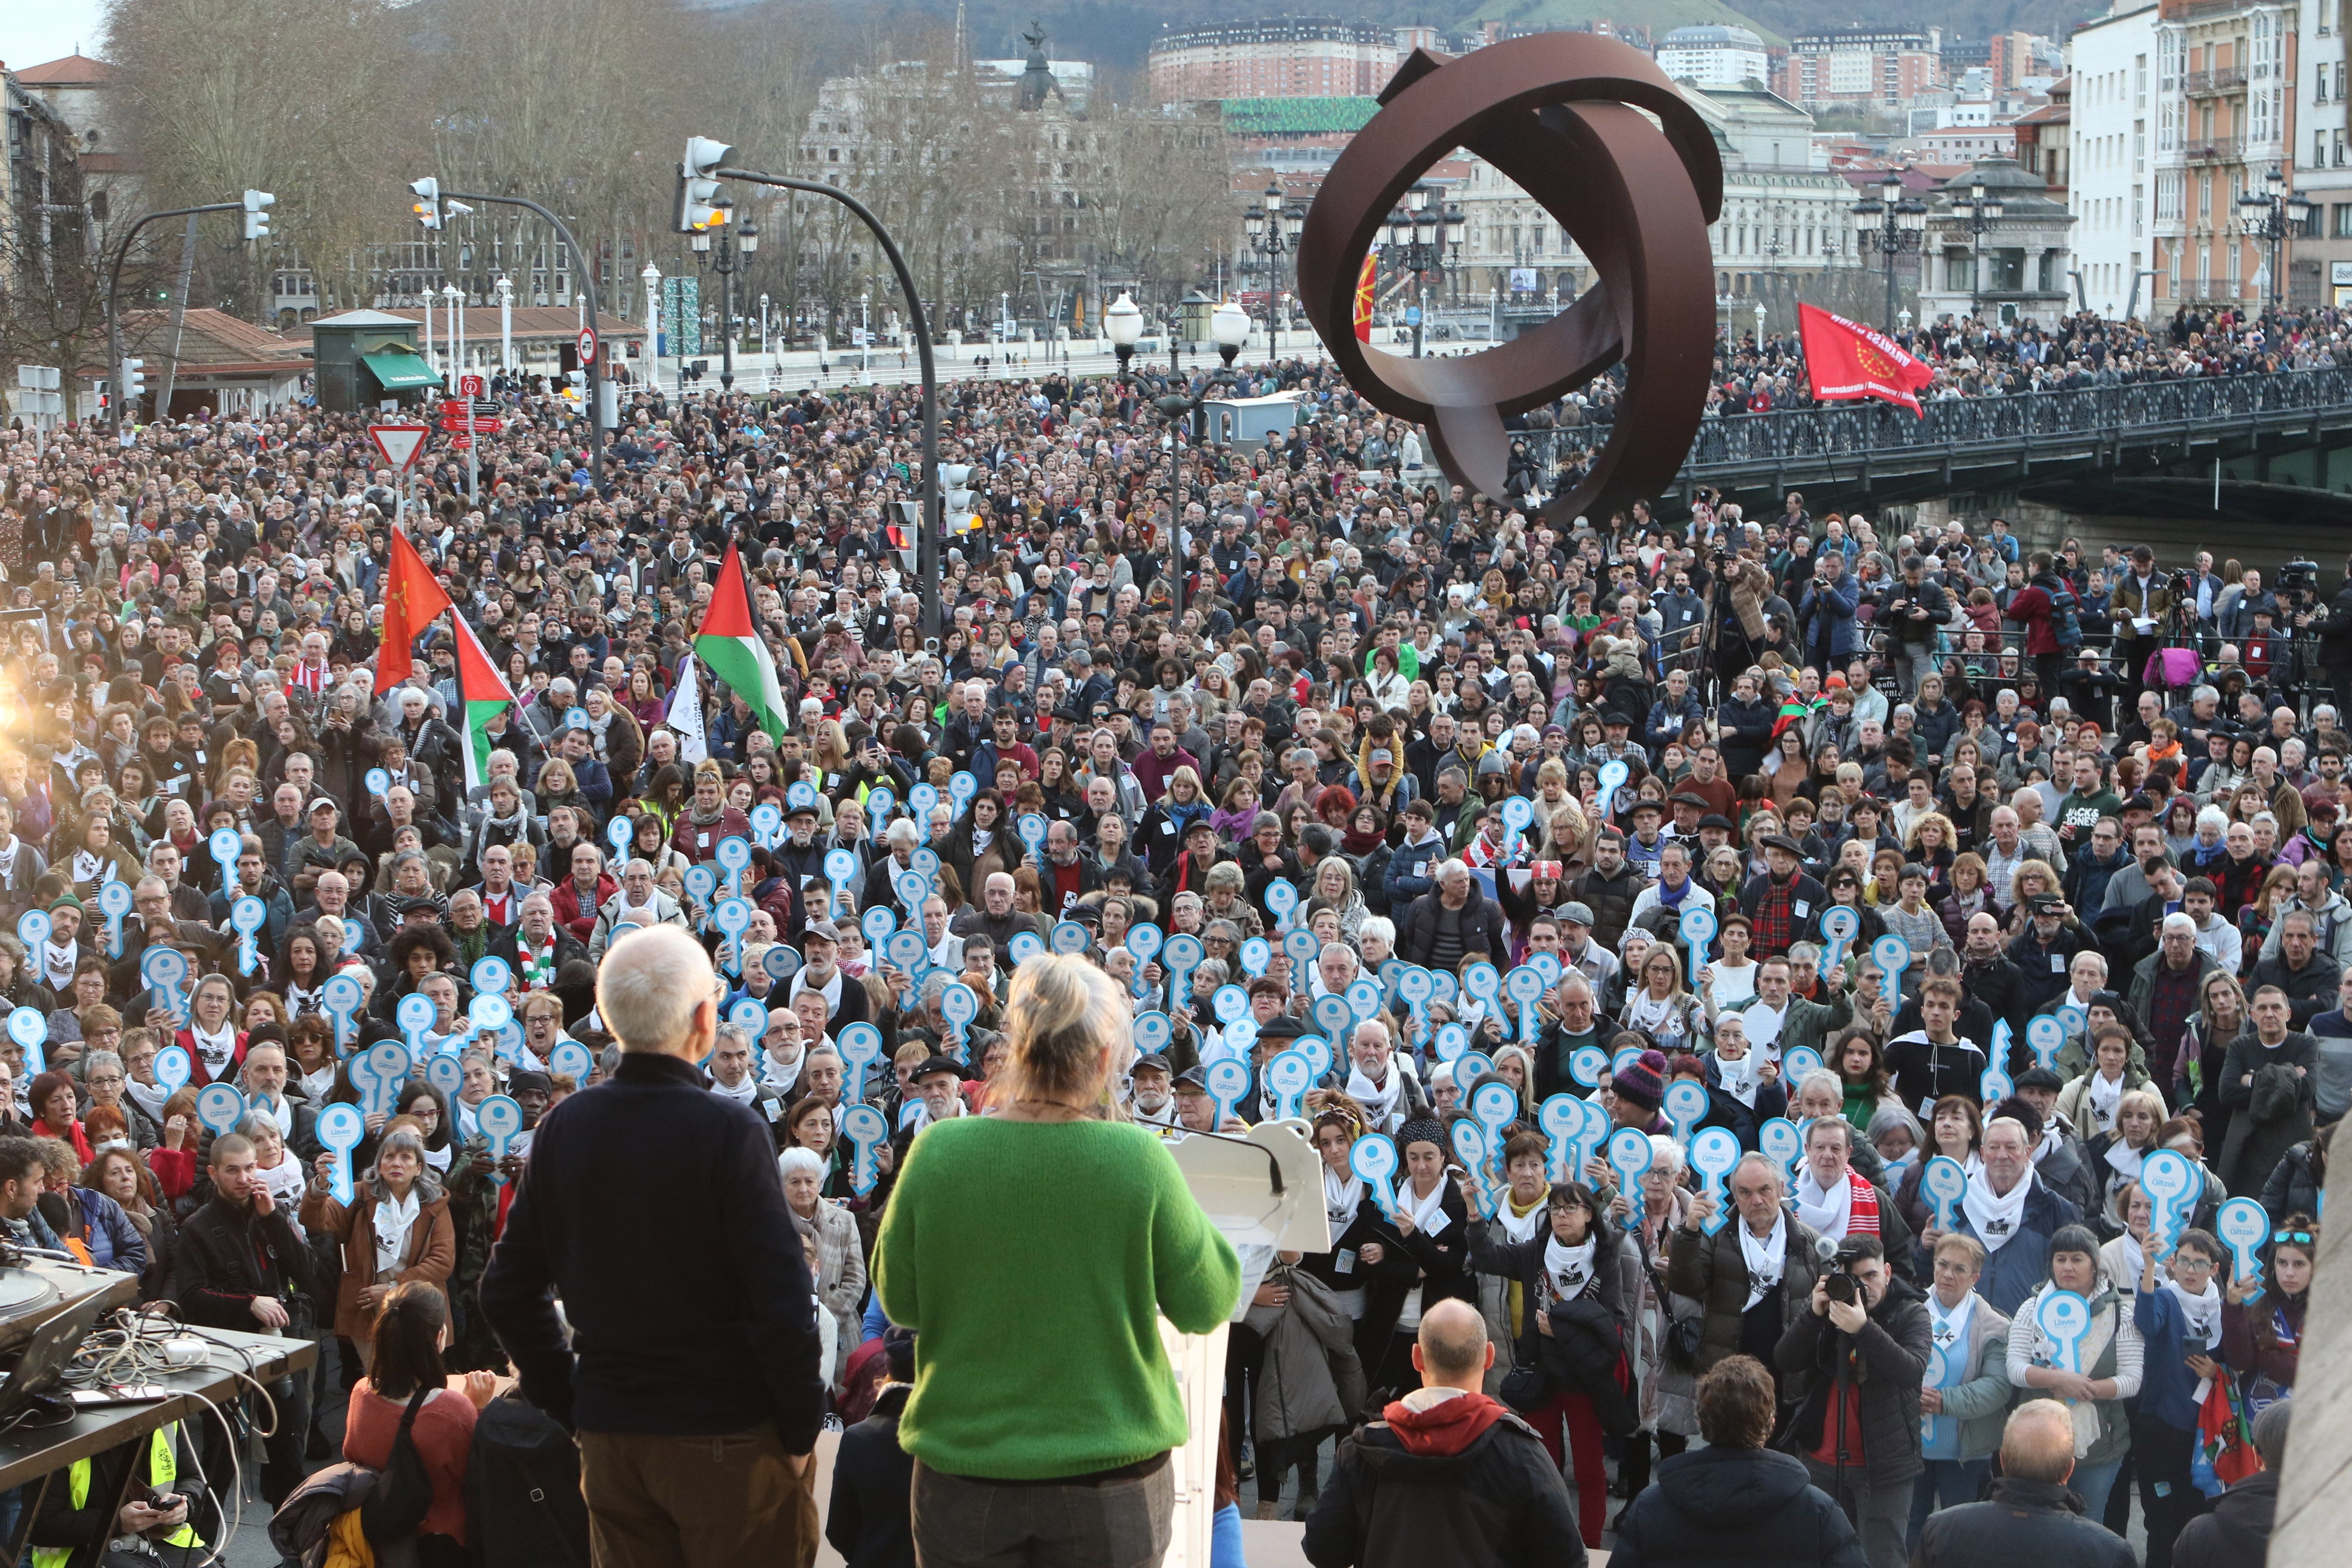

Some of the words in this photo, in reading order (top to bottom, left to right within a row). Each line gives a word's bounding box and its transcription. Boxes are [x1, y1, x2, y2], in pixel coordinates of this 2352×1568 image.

[1868, 381, 1898, 396] Recuperar
[2066, 808, 2099, 817] JACK&
[201, 1055, 224, 1064] txerat
[1585, 1065, 1600, 1075] Llaves
[1366, 1158, 1384, 1167] Llaves
[1935, 1182, 1955, 1192] Giltzak
[2152, 1179, 2176, 1188] Giltzak
[1561, 1278, 1584, 1287] Etxerat
